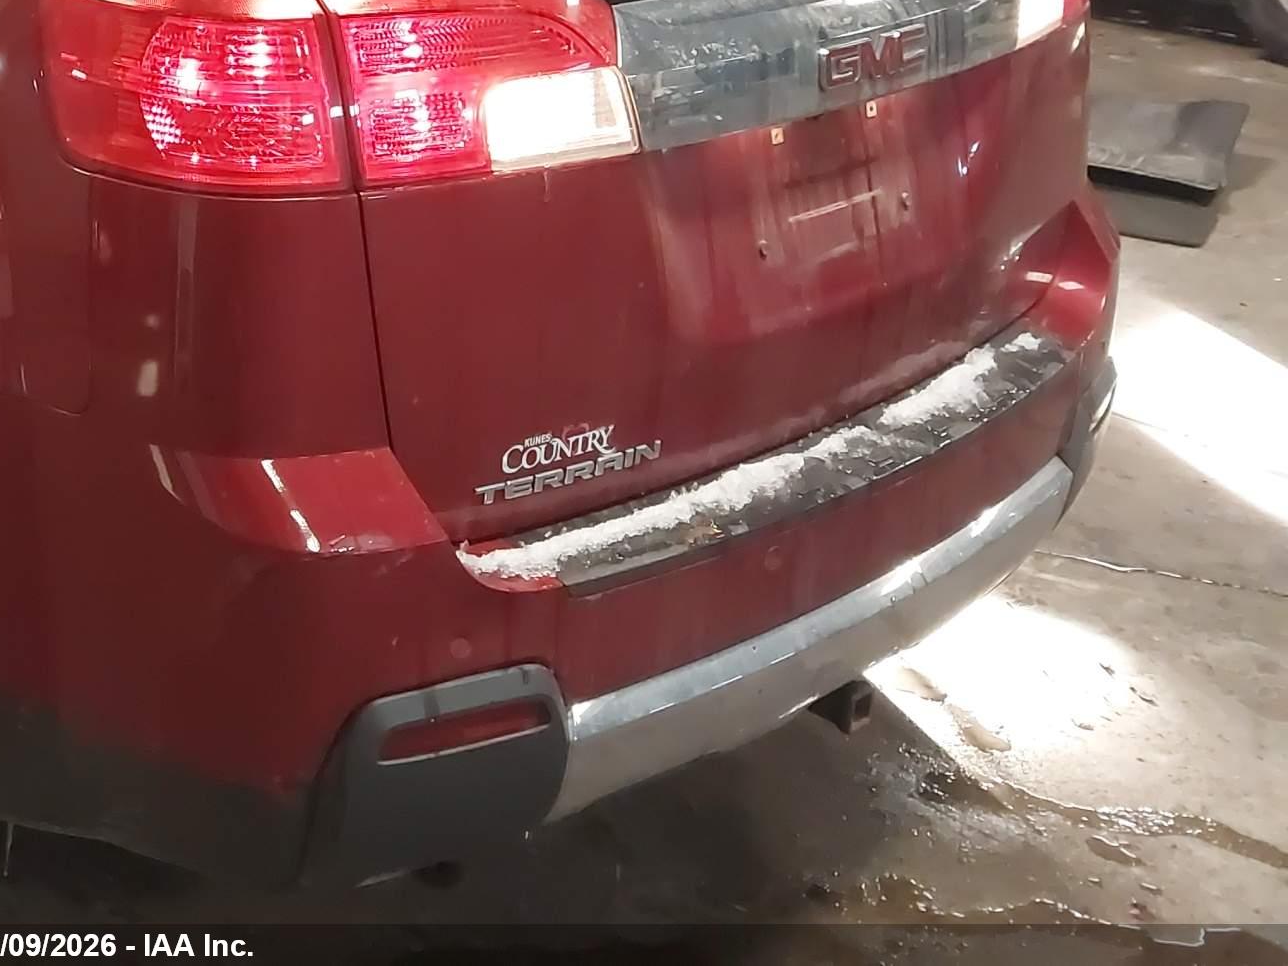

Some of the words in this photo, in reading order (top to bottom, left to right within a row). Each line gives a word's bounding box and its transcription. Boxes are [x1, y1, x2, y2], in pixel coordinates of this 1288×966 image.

[817, 23, 928, 92] GMC
[502, 424, 617, 474] COUNTRY
[524, 433, 552, 447] KUNES
[474, 439, 663, 505] TERRAIN
